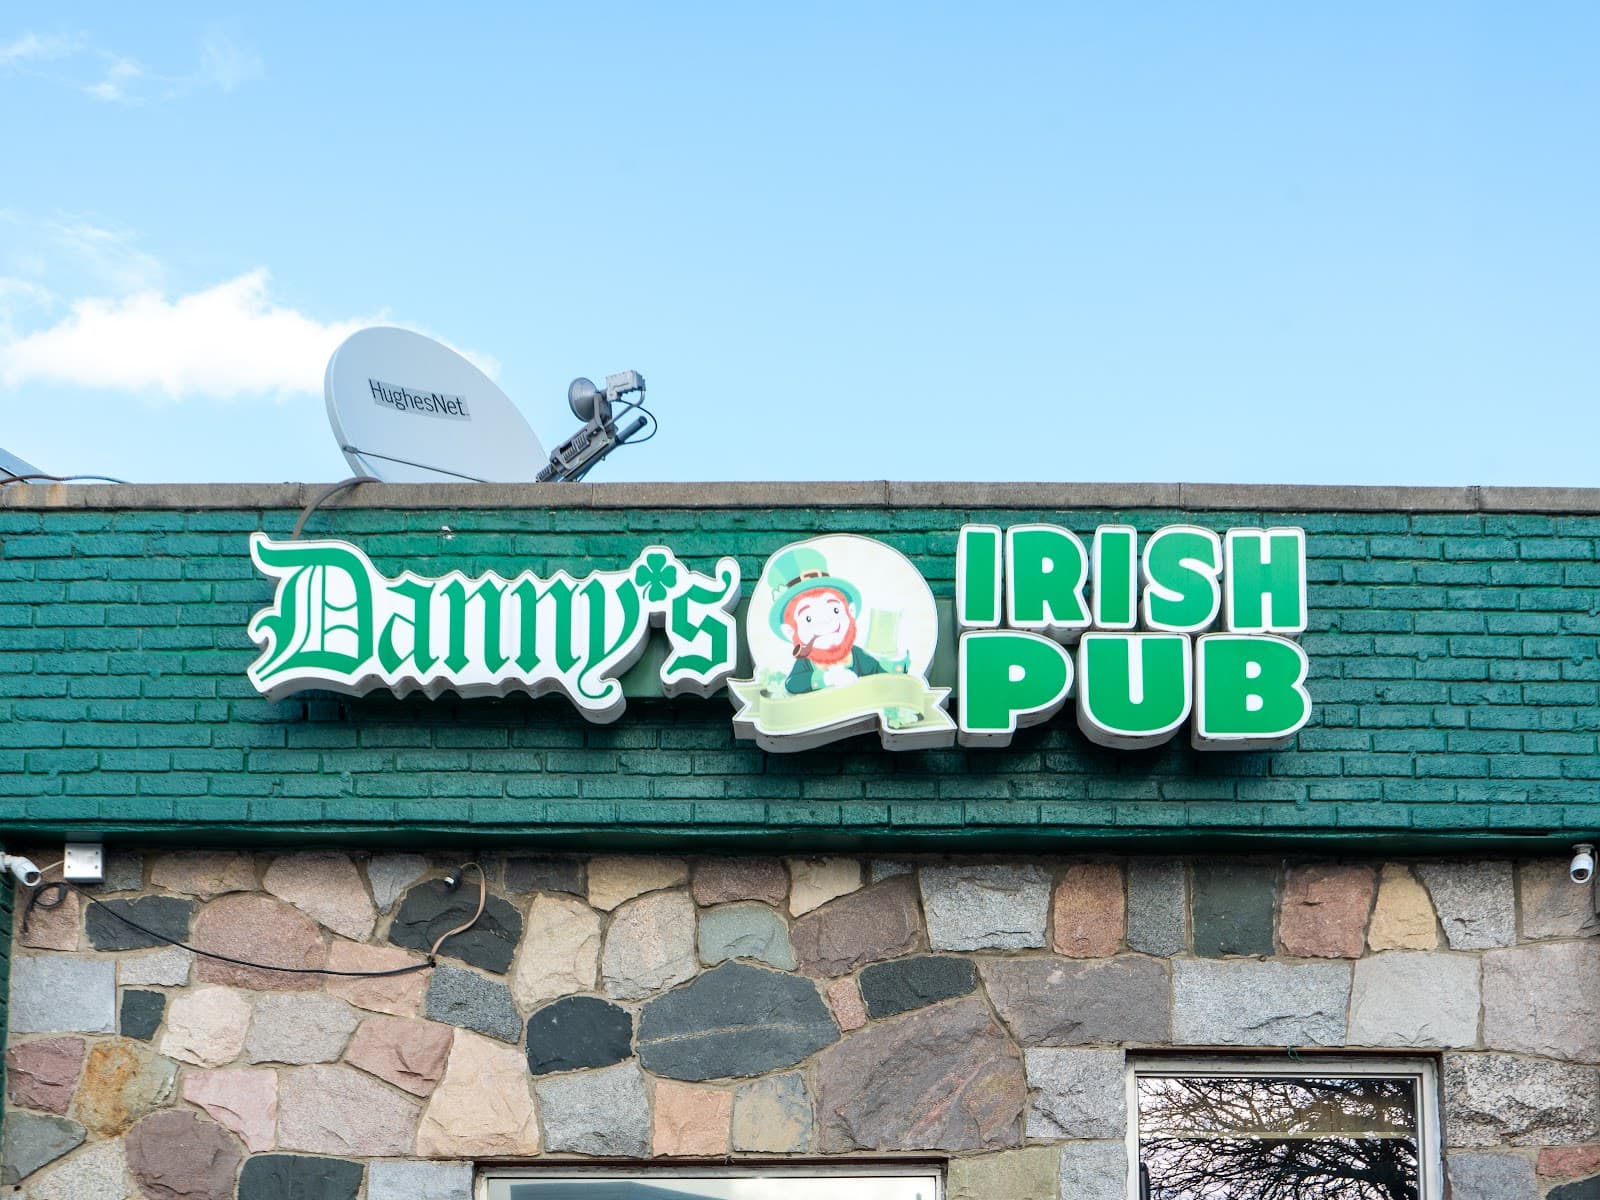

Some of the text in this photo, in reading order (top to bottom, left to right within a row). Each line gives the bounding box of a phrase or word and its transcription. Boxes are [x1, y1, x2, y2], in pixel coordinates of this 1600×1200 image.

[368, 379, 465, 416] HughesNet
[254, 540, 733, 700] Danny's
[962, 528, 1304, 630] IRISH
[962, 634, 1309, 736] PUB
